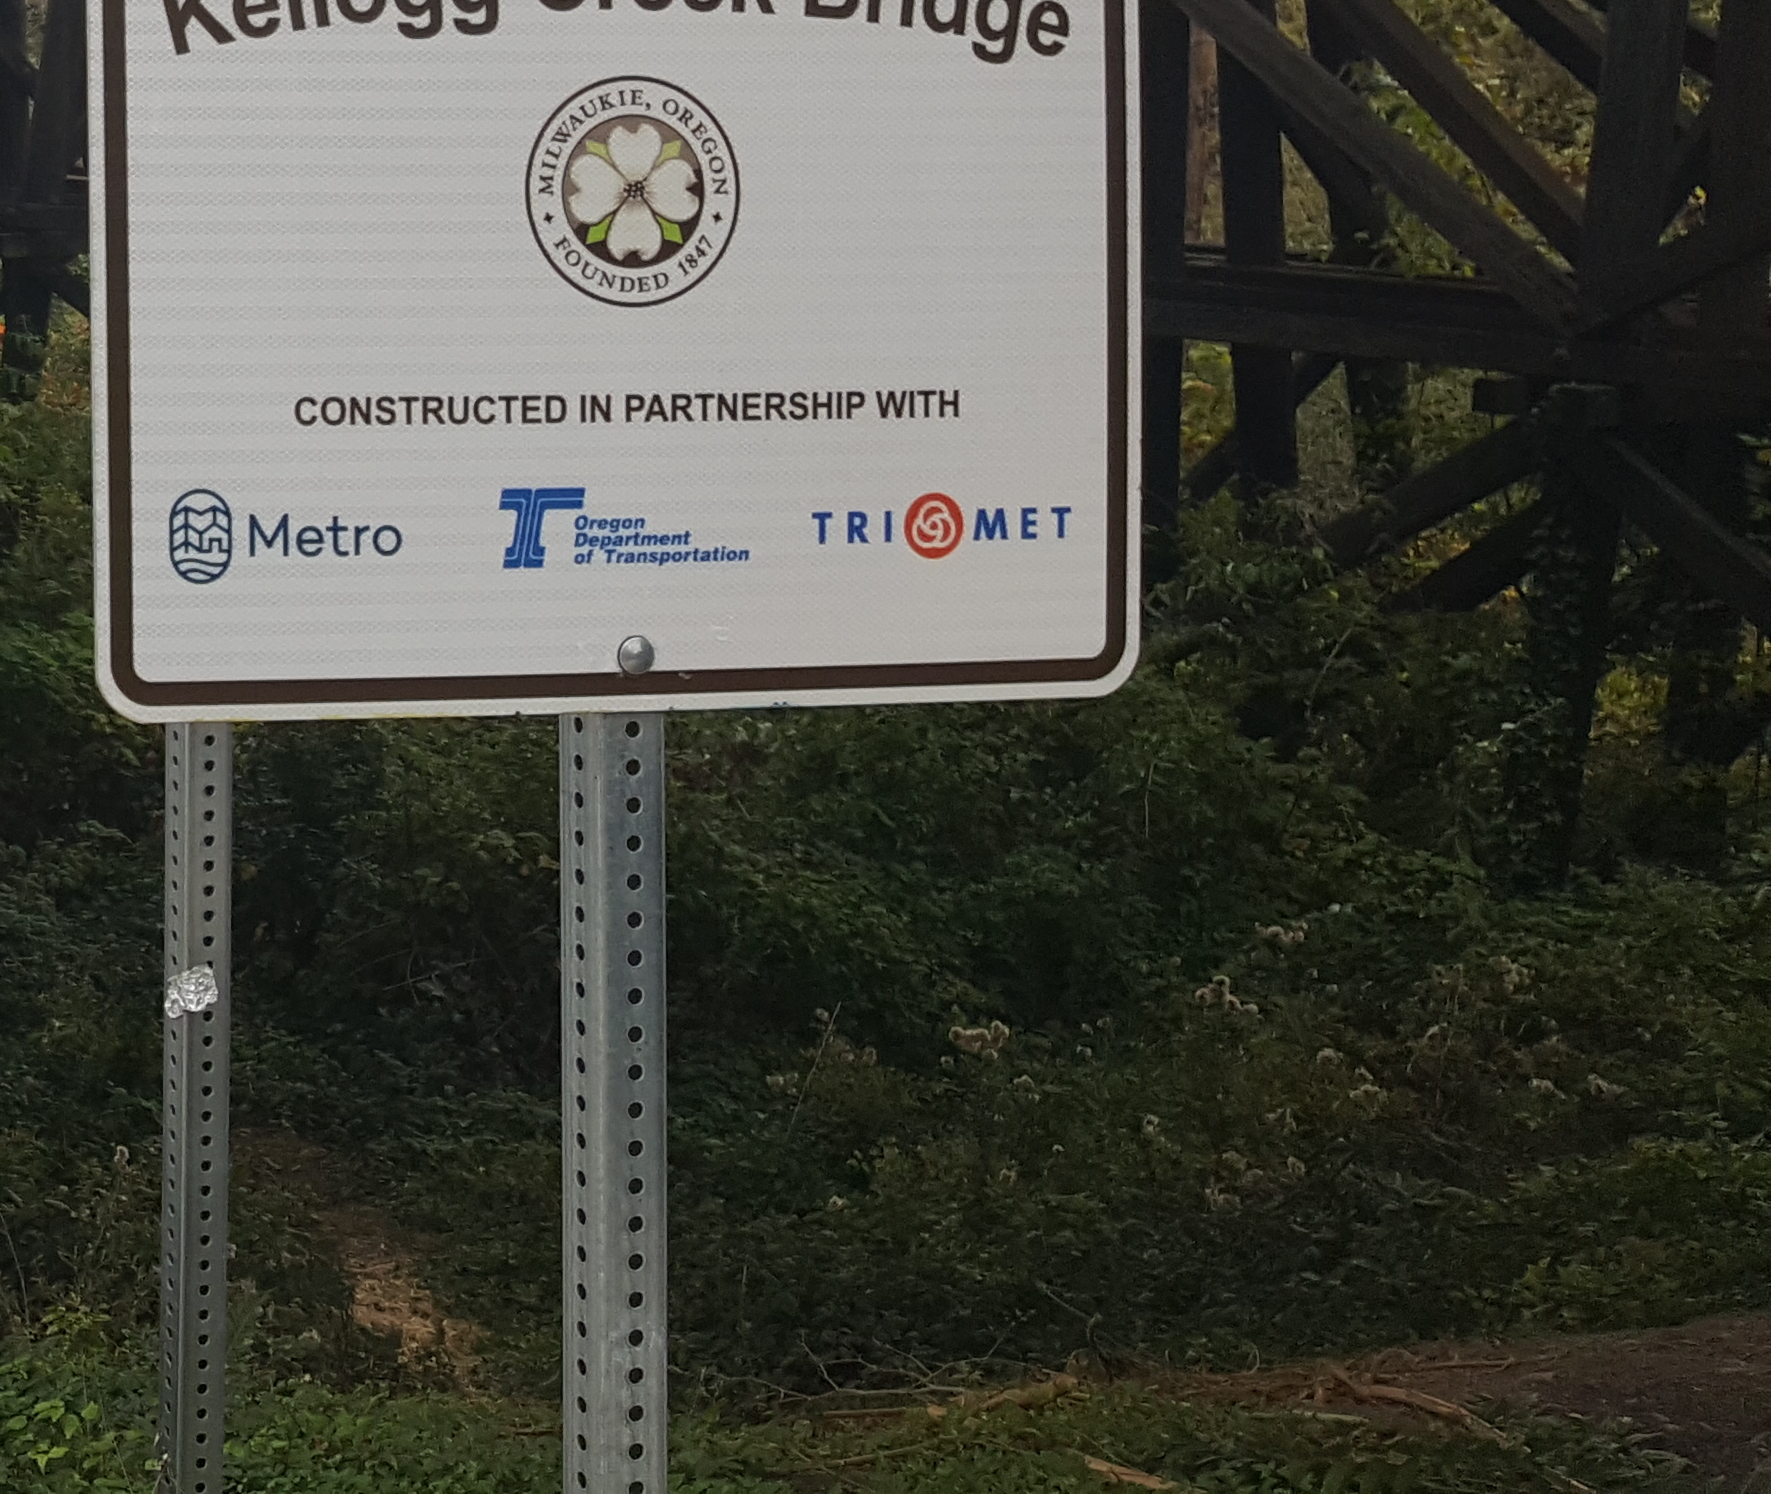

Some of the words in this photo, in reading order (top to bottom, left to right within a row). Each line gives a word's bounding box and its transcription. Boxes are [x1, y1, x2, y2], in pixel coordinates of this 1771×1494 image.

[539, 89, 651, 196] MILWAUKIE,
[661, 98, 729, 196] OREGON
[552, 234, 670, 293] FOUNDED
[676, 234, 715, 277] 1847
[295, 395, 567, 426] CONSTRUCTED
[581, 395, 611, 423] IN
[626, 391, 865, 422] PARTNERSHIP
[876, 390, 959, 418] WITH
[249, 514, 402, 557] Metro
[574, 515, 646, 532] Oregon
[574, 531, 691, 549] Department
[574, 550, 594, 565] of
[604, 546, 751, 567] Transportation
